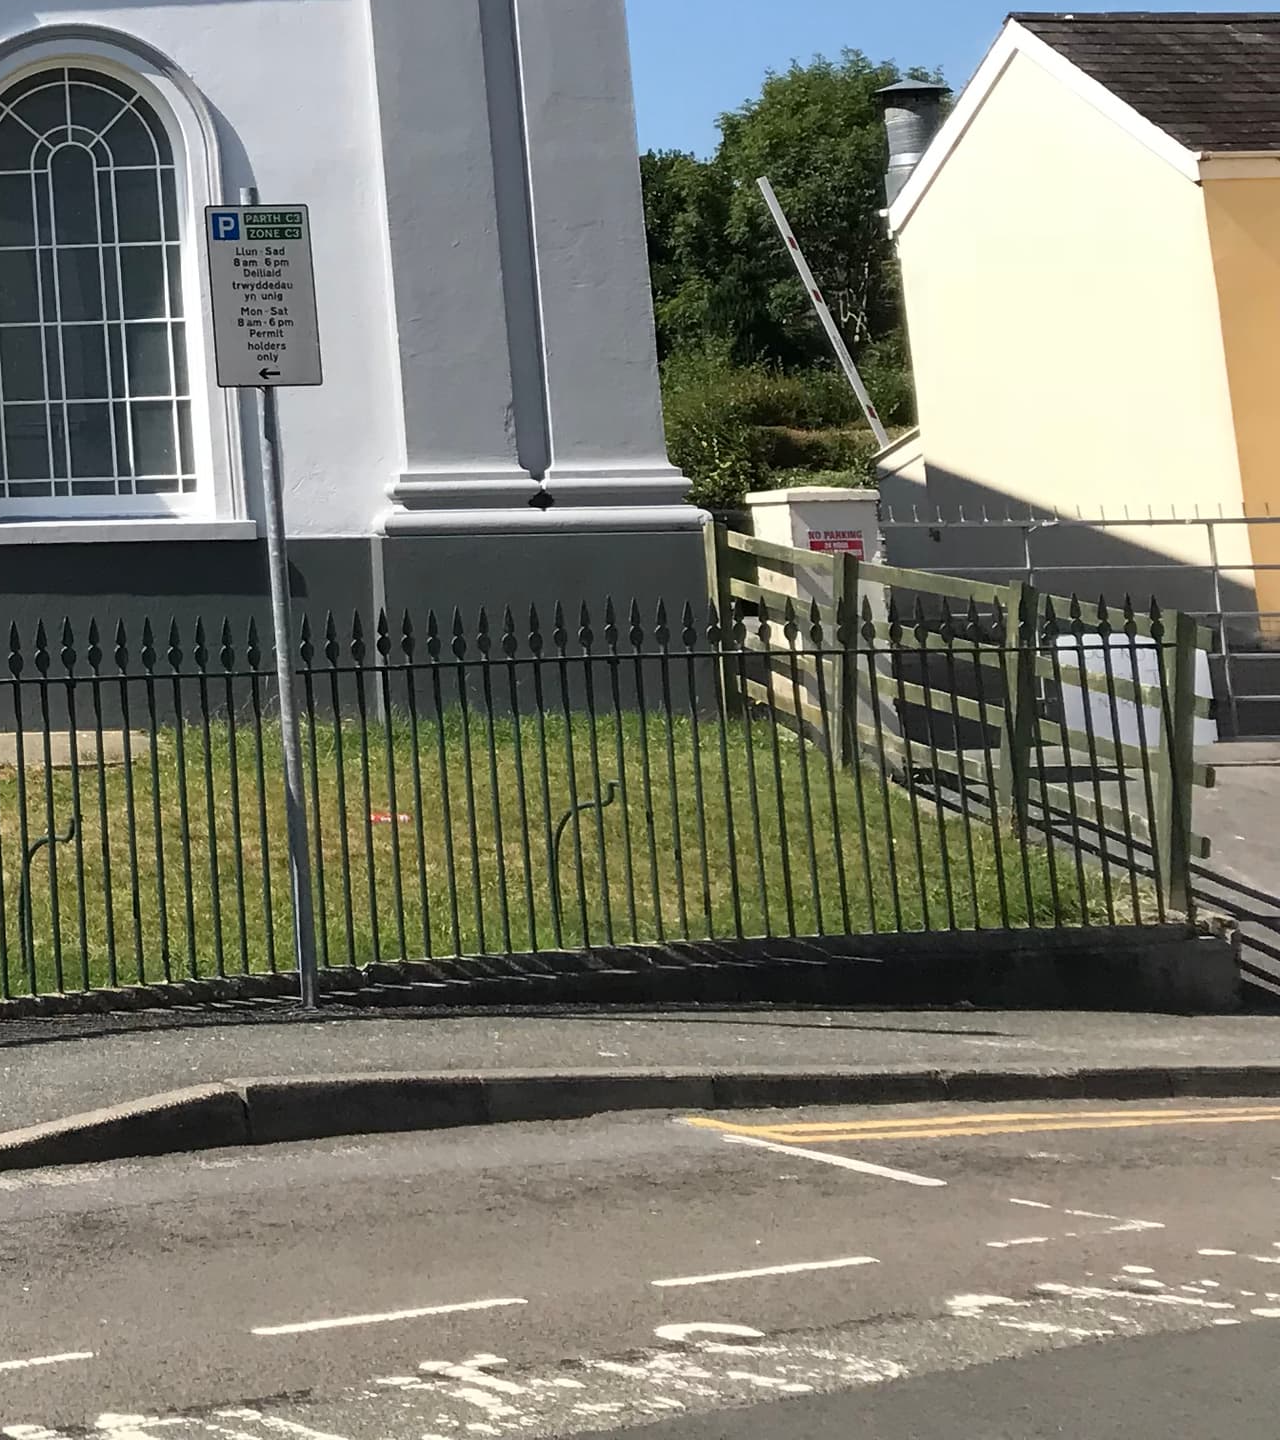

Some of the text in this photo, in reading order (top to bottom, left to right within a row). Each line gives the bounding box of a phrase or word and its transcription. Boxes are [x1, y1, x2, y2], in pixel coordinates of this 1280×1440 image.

[245, 214, 301, 224] PARTH C3
[249, 229, 300, 238] ZONE C3
[235, 246, 258, 256] Llun
[265, 246, 285, 256] Sad
[232, 281, 293, 292] trwyddedau
[244, 292, 283, 302] yn unig
[241, 306, 263, 316] Mon
[270, 306, 289, 316] Sat
[249, 329, 284, 338] Permit
[247, 341, 287, 351] holders
[257, 352, 279, 363] only
